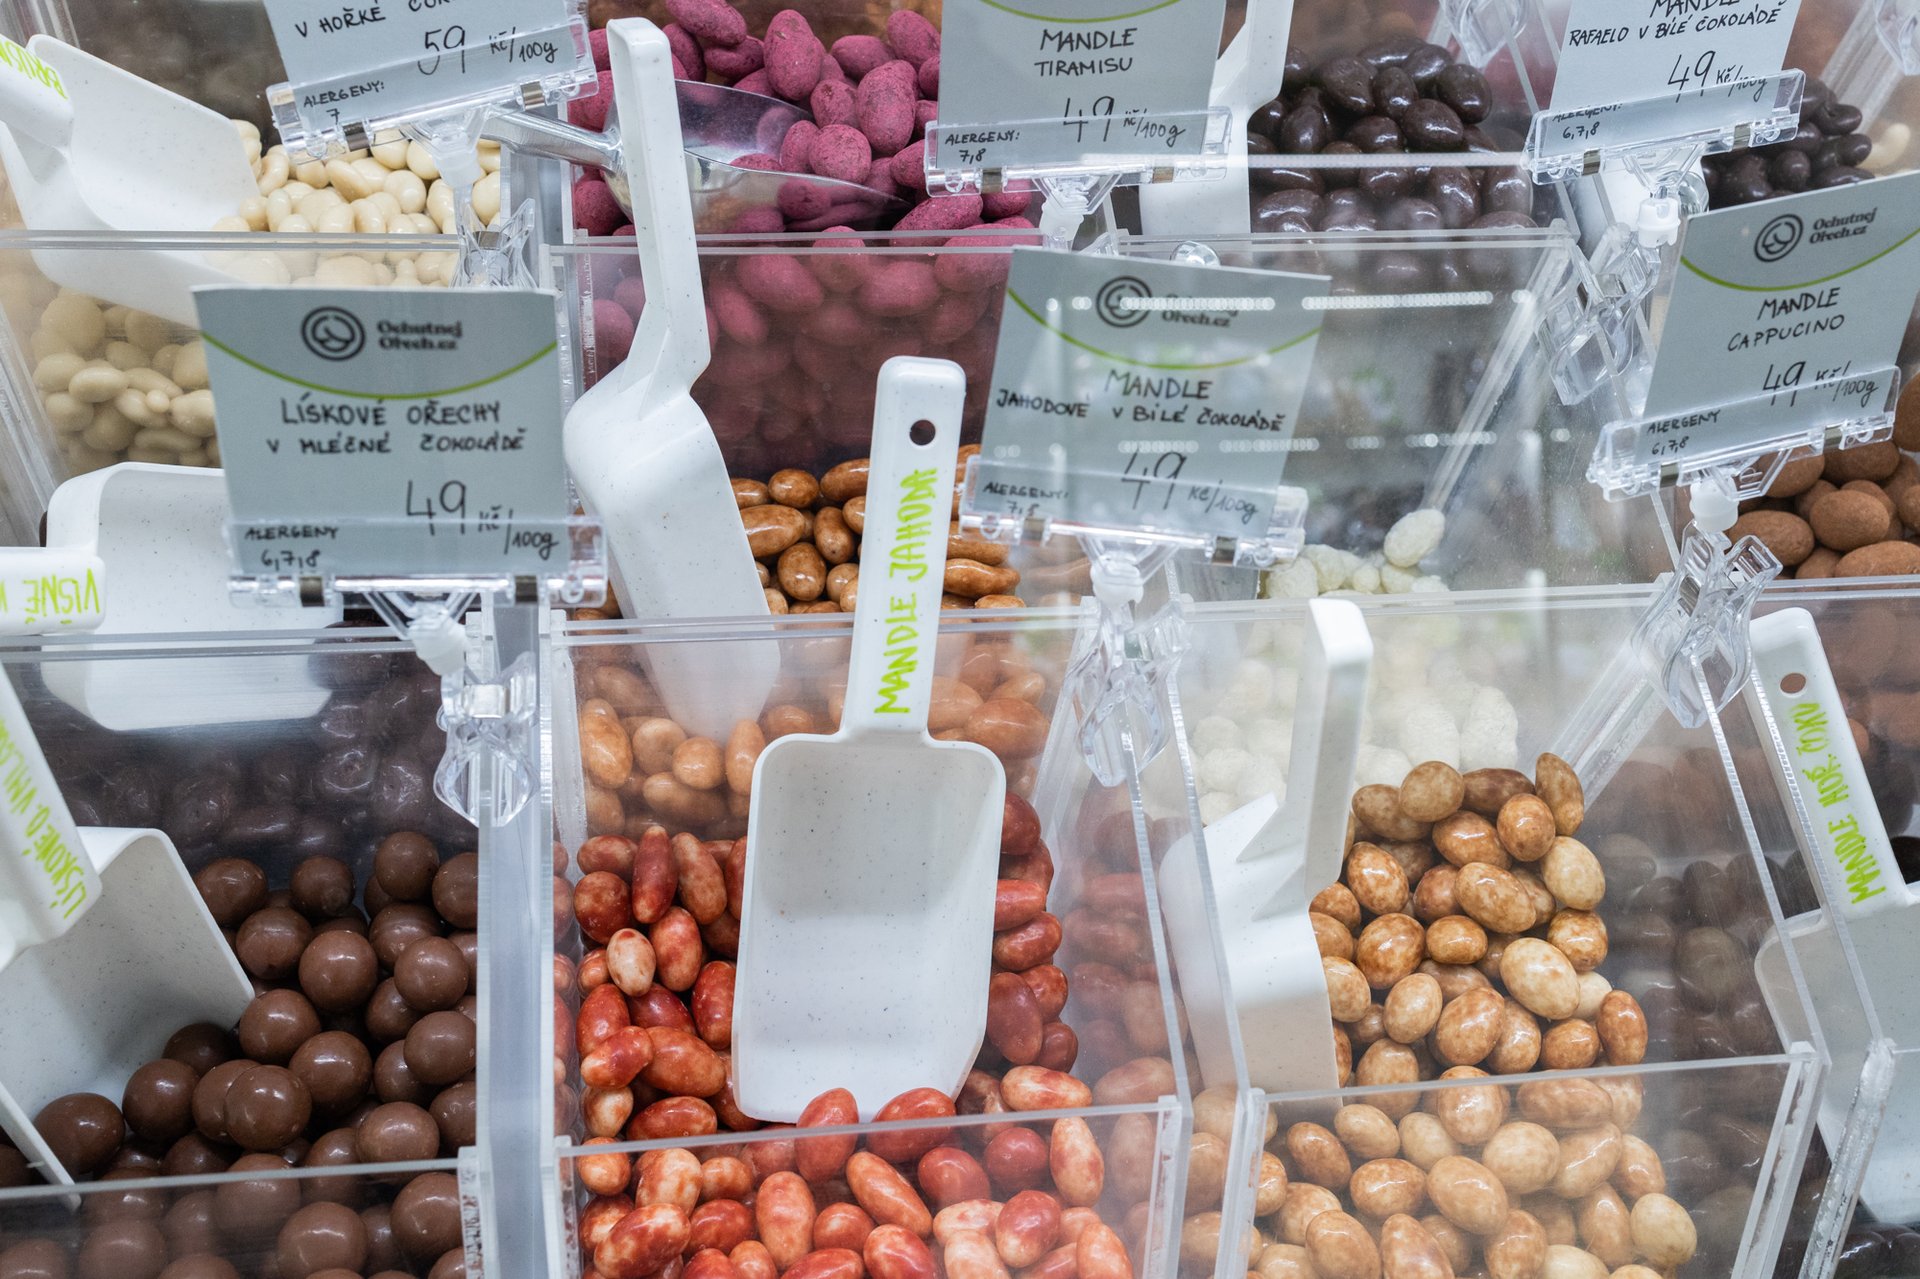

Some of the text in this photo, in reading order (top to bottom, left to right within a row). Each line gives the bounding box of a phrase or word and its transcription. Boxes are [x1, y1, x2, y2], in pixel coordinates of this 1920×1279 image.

[1568, 26, 1629, 47] RAFAELO
[1654, 13, 1694, 39] BÍLÉ
[1694, 0, 1788, 33] ČOKOLÁDĚ
[417, 25, 466, 74] 59
[1039, 27, 1138, 52] MANDLE
[1033, 56, 1134, 77] TIRAMISU
[1666, 50, 1716, 103] 49
[302, 80, 386, 108] ALERGENY:
[325, 108, 340, 126] 7
[1062, 96, 1115, 142] 49
[1562, 121, 1600, 140] 6,7,8
[944, 130, 1021, 146] ALERGENY:
[958, 148, 988, 163] 7,8
[1812, 206, 1878, 231] Ochutnej
[1757, 287, 1841, 321] MANDLE
[377, 319, 463, 338] Ochutnej
[1727, 314, 1846, 352] CAPPUCINO
[1104, 368, 1213, 400] MANDLE
[1761, 360, 1807, 408] 49
[280, 391, 500, 426] LÍSKOVÉ OŘECHY
[1132, 402, 1189, 424] BÍLÉ
[1196, 406, 1287, 432] ČOKOLÁDĚ
[1646, 409, 1722, 436] ALERGENY
[299, 430, 393, 455] MLÉČNÉ
[419, 427, 528, 453] ČOKOLÁDĚ
[1651, 436, 1691, 457] 6,7,8
[1120, 449, 1189, 511] 49
[405, 480, 468, 537] 49
[243, 526, 341, 542] ALERGENY
[260, 549, 322, 572] 6,7,8
[22, 567, 100, 625] VIŠNĚ
[873, 466, 939, 714] MANDLE JAHODA
[1827, 813, 1887, 905] MANDLE
